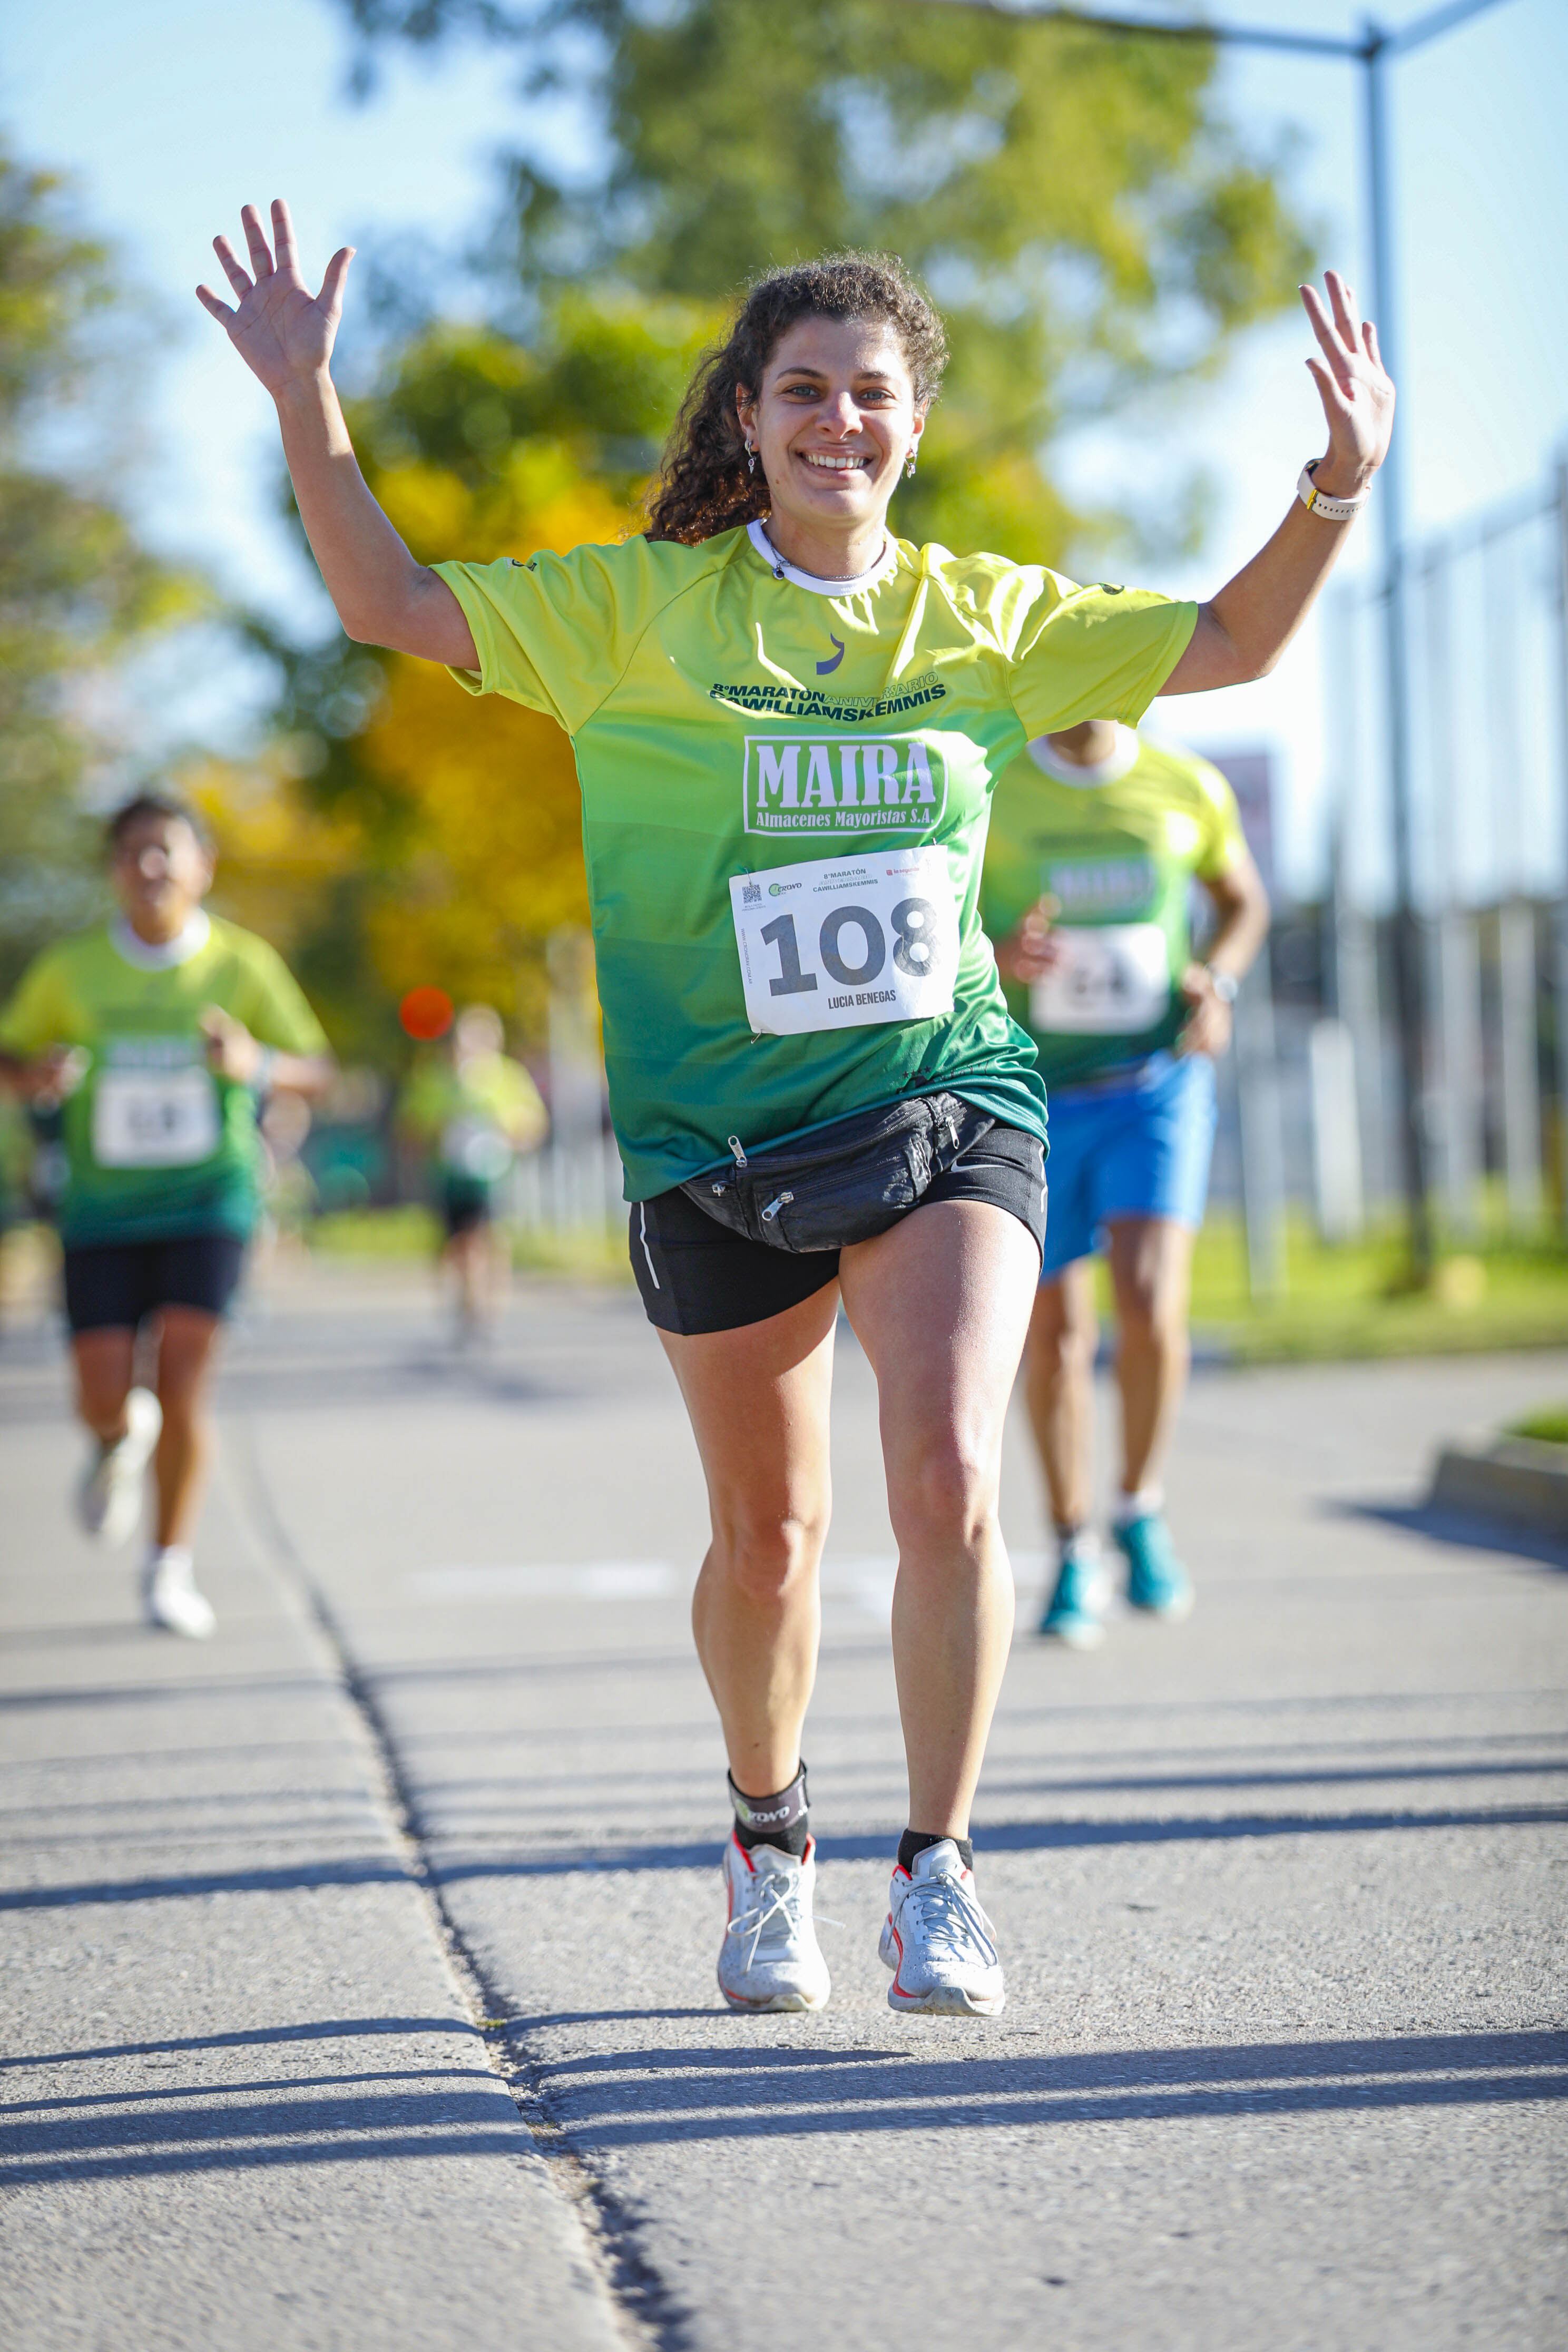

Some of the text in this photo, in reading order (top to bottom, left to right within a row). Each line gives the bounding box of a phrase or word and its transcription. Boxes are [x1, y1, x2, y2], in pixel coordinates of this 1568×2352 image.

[756, 741, 936, 808] MAIRA
[756, 808, 934, 828] Almacenes Mayoristas S.A.
[813, 879, 878, 892] CAWILLIAMSKEMMIS
[760, 897, 937, 996] 108
[828, 989, 896, 1009] LUCIA BENEGAS
